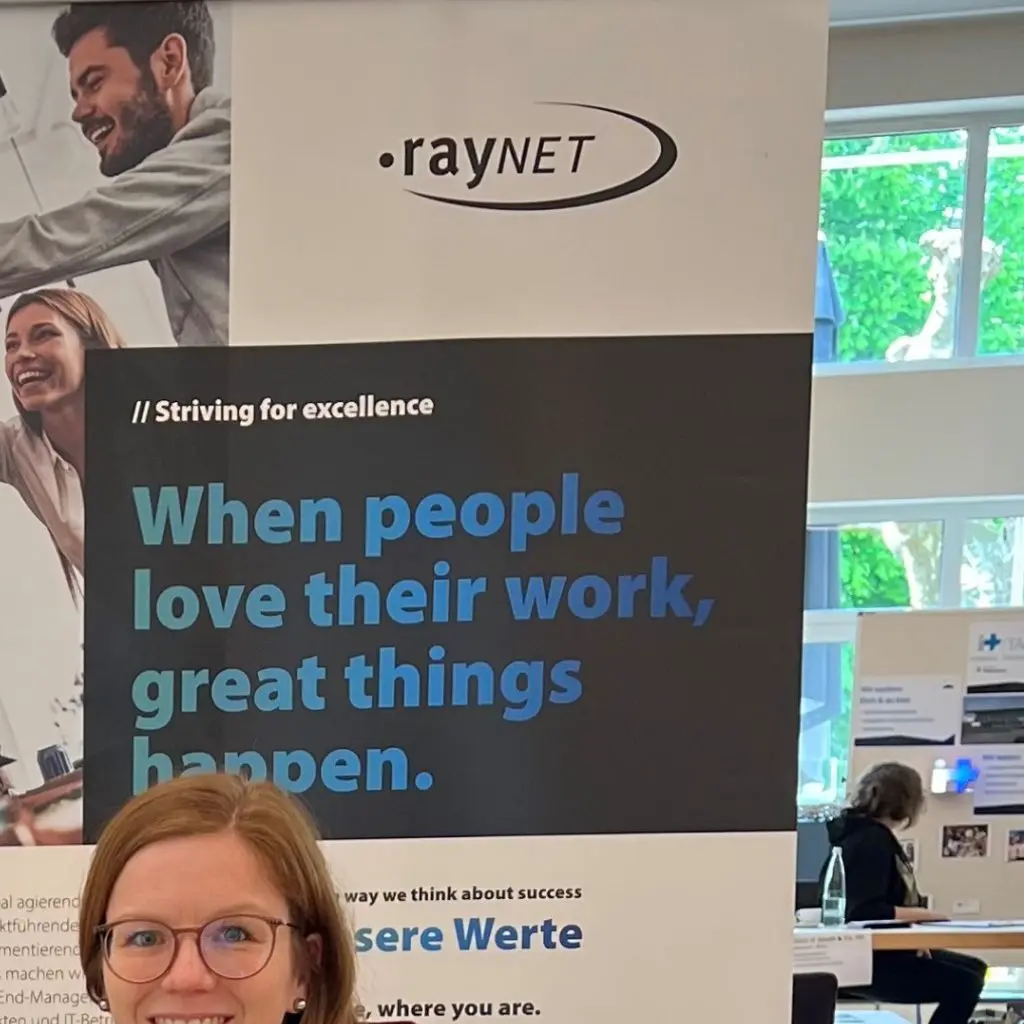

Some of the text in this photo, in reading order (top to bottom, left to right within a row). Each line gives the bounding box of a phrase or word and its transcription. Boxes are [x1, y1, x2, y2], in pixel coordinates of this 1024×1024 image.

[155, 398, 255, 427] Striving
[260, 397, 298, 421] for
[302, 394, 435, 420] excellence
[132, 473, 624, 556] When people
[133, 557, 715, 630] love their work,
[131, 646, 583, 730] great things
[345, 888, 378, 905] way
[383, 892, 407, 902] we
[411, 886, 457, 902] think
[461, 886, 514, 901] about
[518, 887, 582, 900] success
[355, 917, 583, 952] sere Werte
[5, 966, 64, 981] machen
[378, 999, 446, 1017] where
[452, 1002, 492, 1021] you
[498, 1001, 541, 1016] are.
